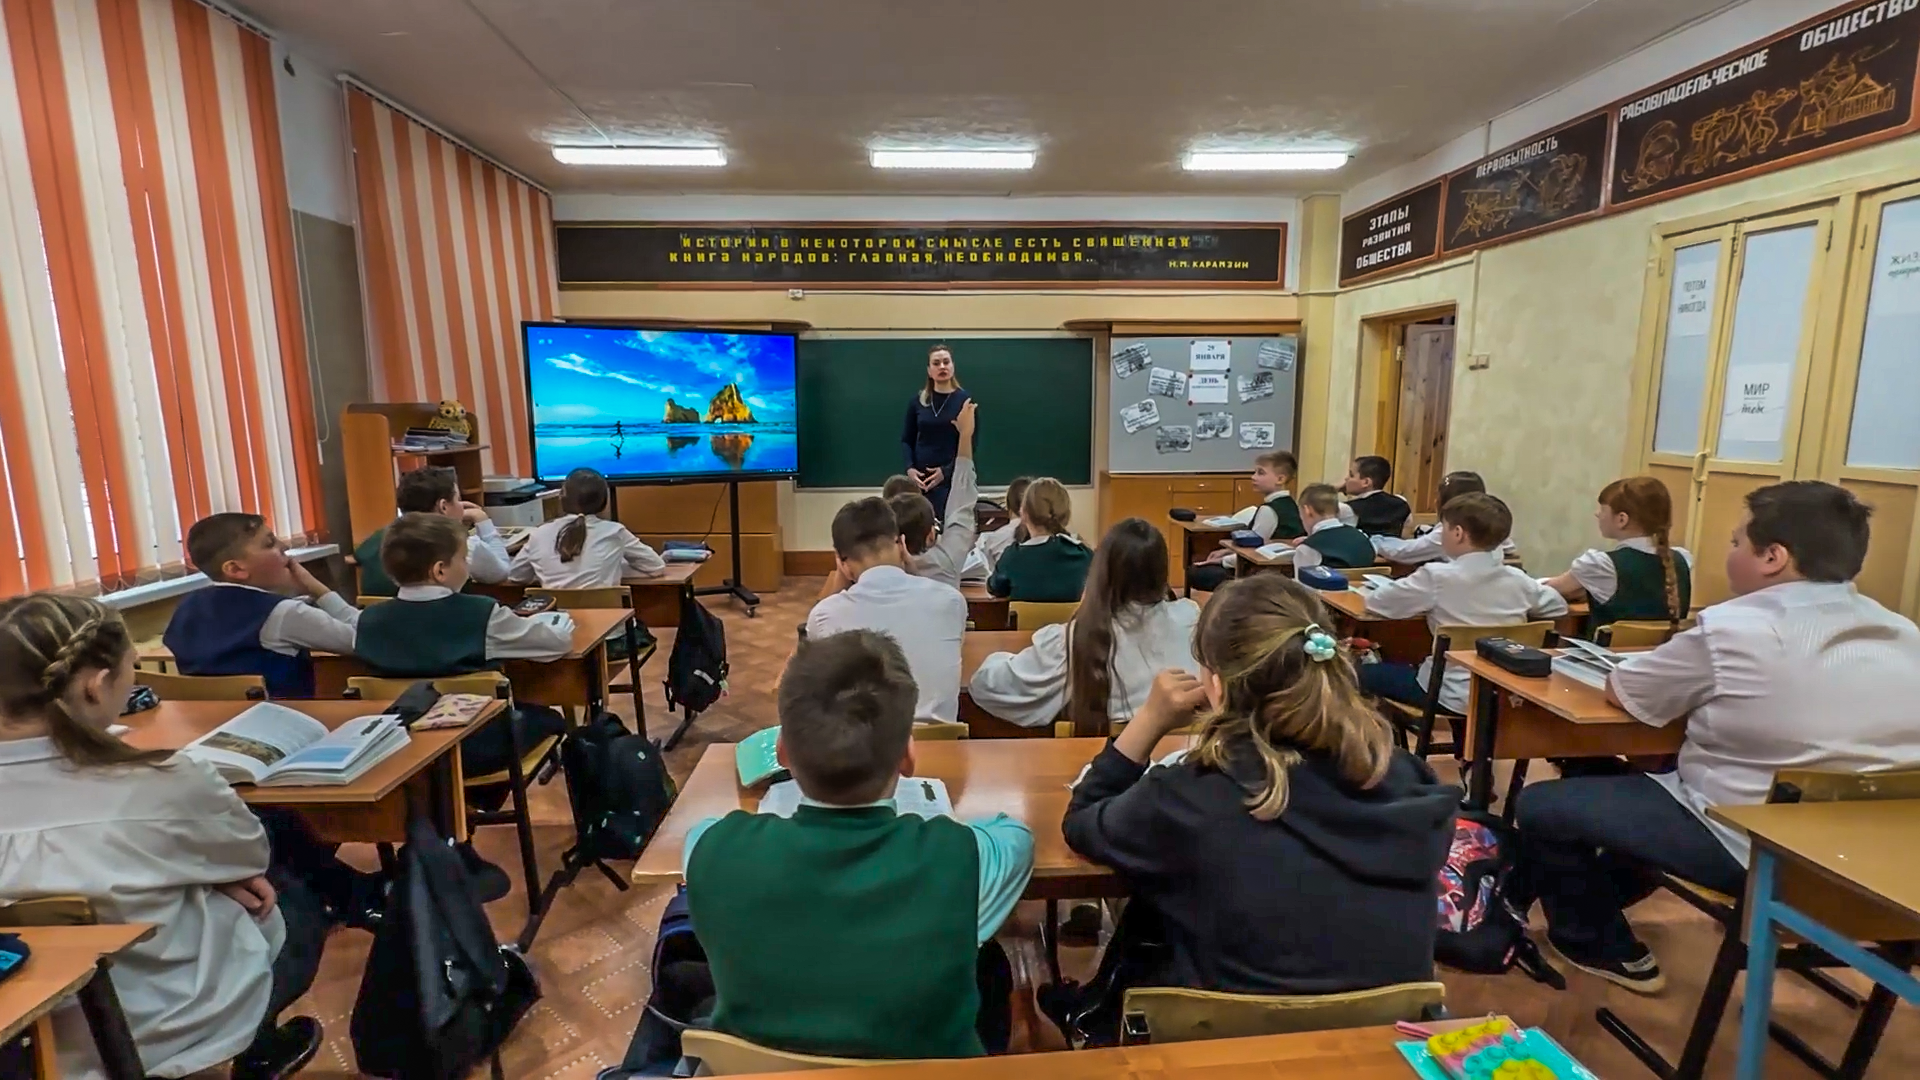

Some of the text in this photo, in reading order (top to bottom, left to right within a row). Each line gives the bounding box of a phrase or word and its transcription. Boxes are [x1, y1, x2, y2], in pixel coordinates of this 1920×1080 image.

[1619, 48, 1769, 122] РАБОВЛАДЕЛЬЧЕСКОЕ
[1475, 136, 1558, 178] ПЕРВОБЫТНОСТЬ
[1369, 204, 1410, 231] ЭТАПЫ
[682, 237, 769, 249] ИСТОРИЯ
[780, 237, 789, 249] В
[800, 237, 916, 249] НЕКОТОРОМ
[926, 237, 1002, 249] СМЫСЛЕ
[1014, 237, 1062, 249] ЕСТЬ
[1362, 222, 1412, 248] РАЗВИТИЯ
[1192, 260, 1249, 270] КАРАМЗИН
[1355, 240, 1412, 270] ОБЩЕСТВА
[1743, 383, 1770, 396] МИР
